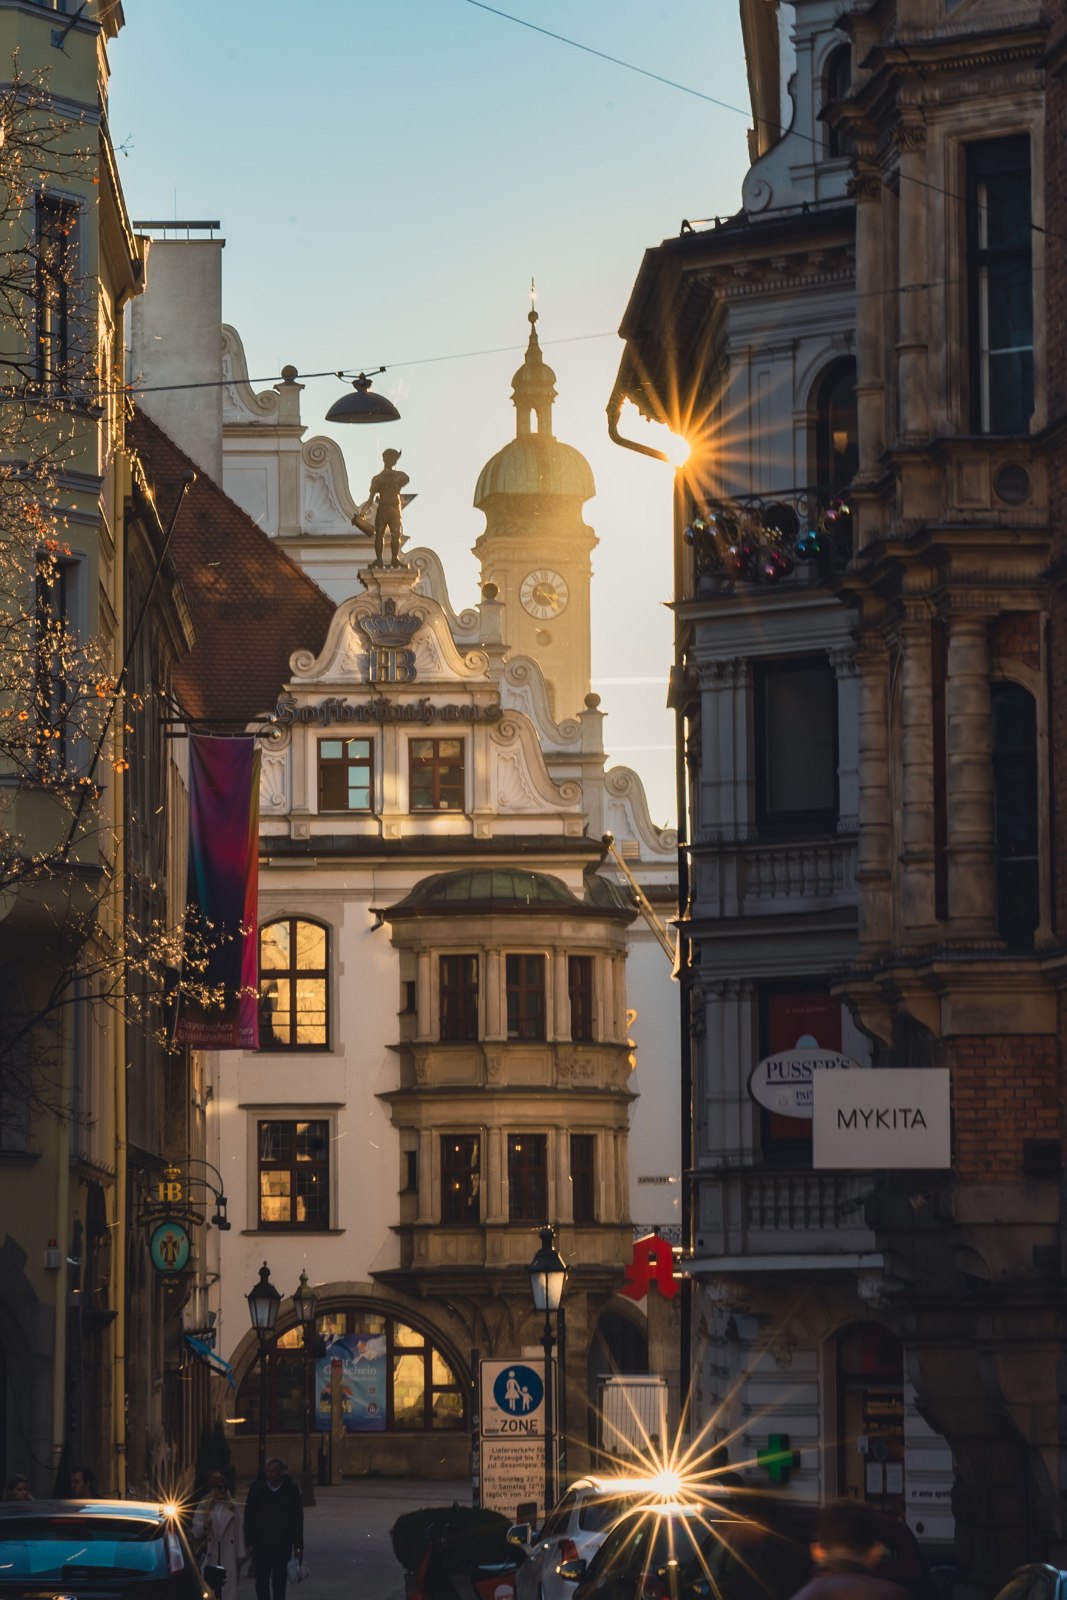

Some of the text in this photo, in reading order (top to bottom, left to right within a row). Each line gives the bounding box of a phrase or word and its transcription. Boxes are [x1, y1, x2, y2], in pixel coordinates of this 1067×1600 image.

[368, 648, 417, 683] HB
[837, 1108, 928, 1130] MYKITA
[158, 1182, 182, 1202] HB
[323, 1364, 377, 1376] Gschein
[500, 1420, 538, 1432] ZONE
